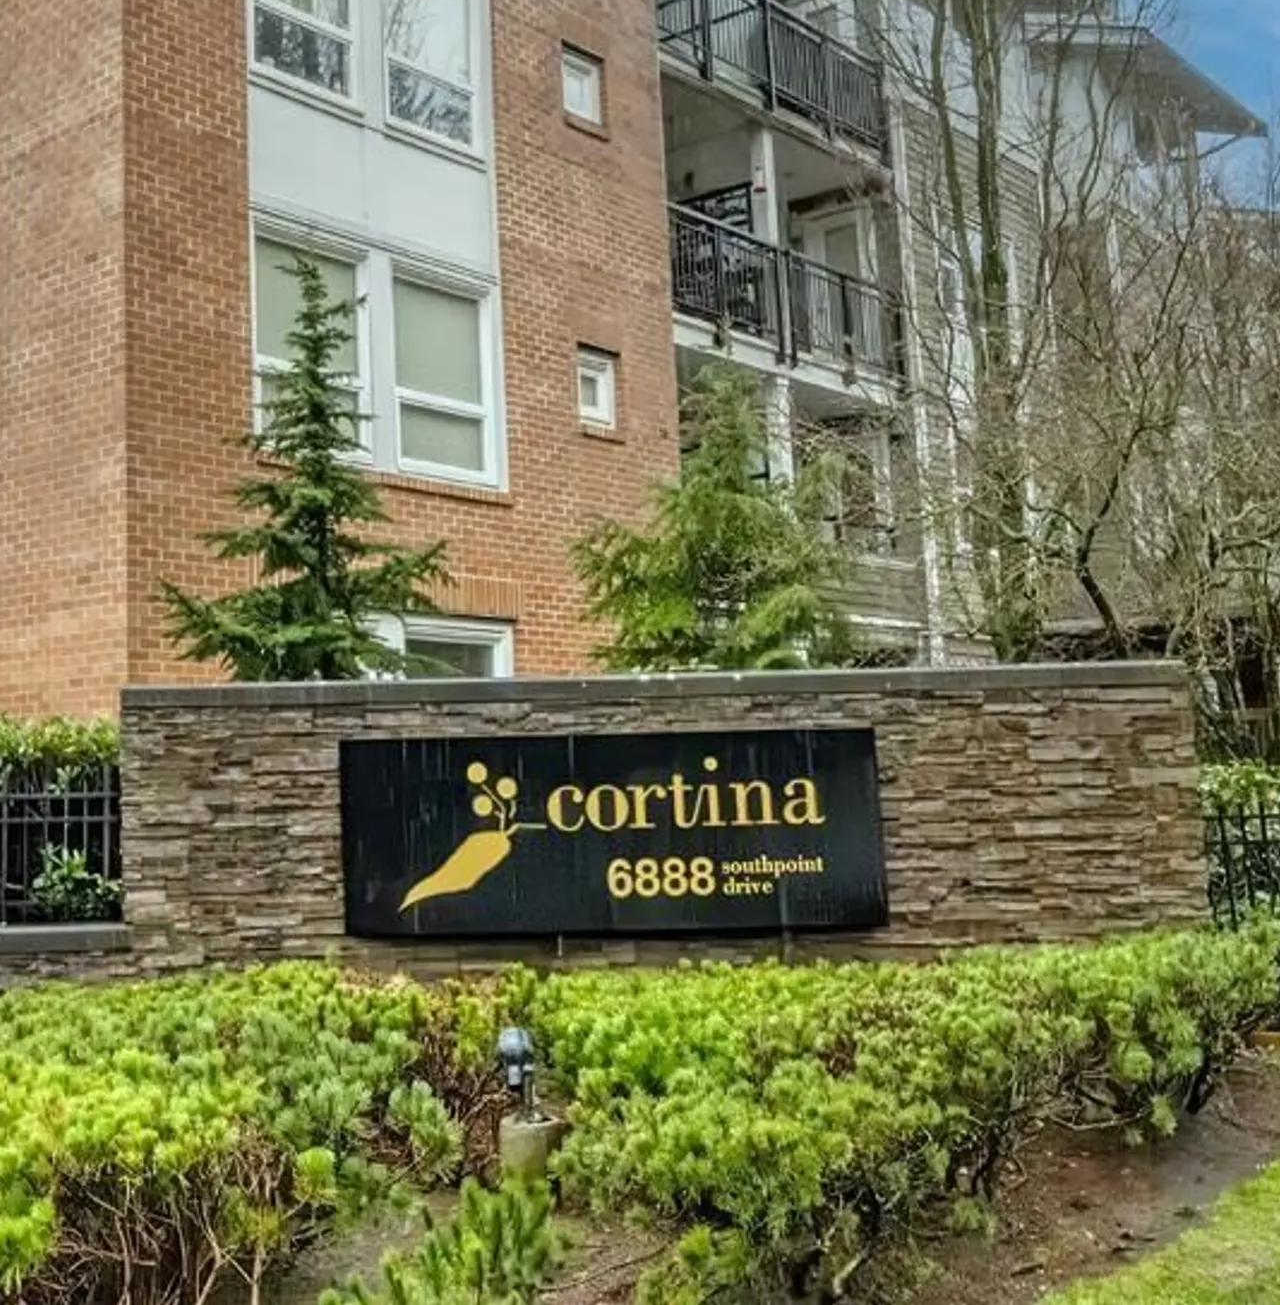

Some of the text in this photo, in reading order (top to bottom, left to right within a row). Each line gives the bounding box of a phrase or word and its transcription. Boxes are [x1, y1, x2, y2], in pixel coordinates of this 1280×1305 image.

[546, 756, 827, 832] cortina
[606, 855, 716, 898] 6888
[721, 854, 825, 879] southpoint
[723, 877, 774, 895] drive
